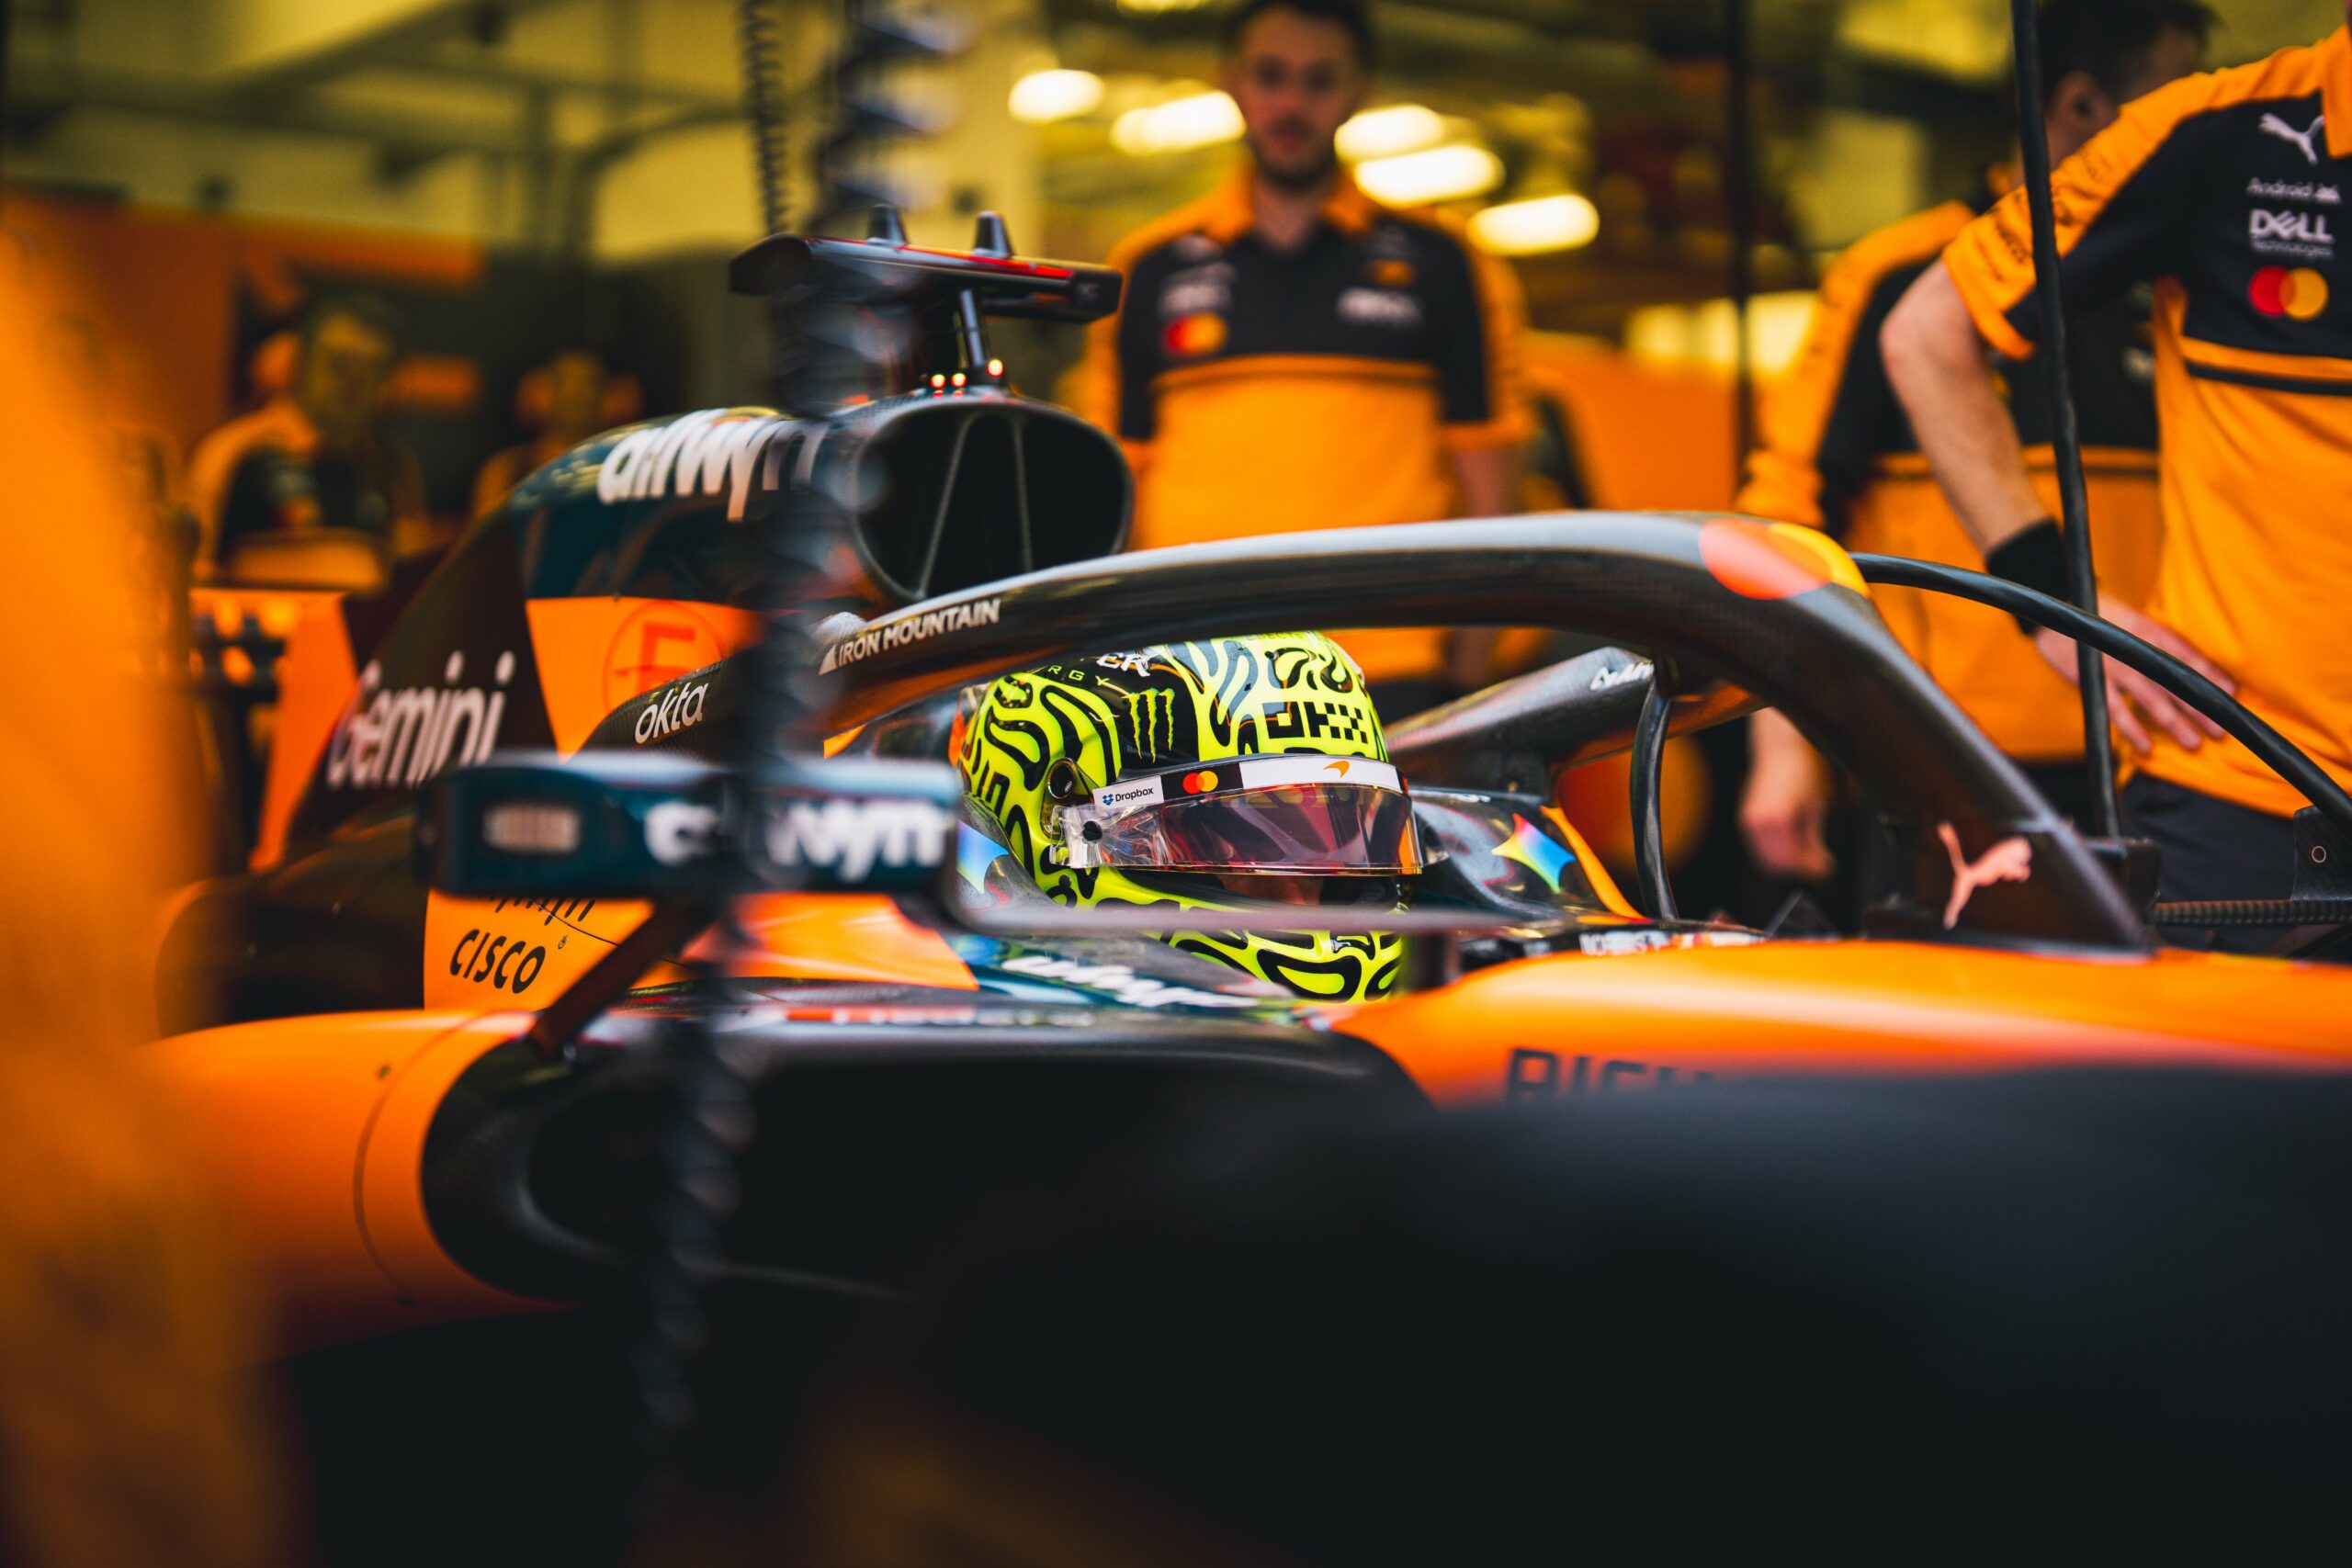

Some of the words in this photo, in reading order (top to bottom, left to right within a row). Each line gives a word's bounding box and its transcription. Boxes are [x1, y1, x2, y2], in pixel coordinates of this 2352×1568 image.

[2249, 209, 2335, 244] DELL
[838, 630, 881, 666] IRON
[883, 598, 1001, 650] MOUNTAIN
[326, 649, 516, 788] Gemini
[634, 682, 709, 745] okta
[1114, 786, 1155, 802] Dropbox
